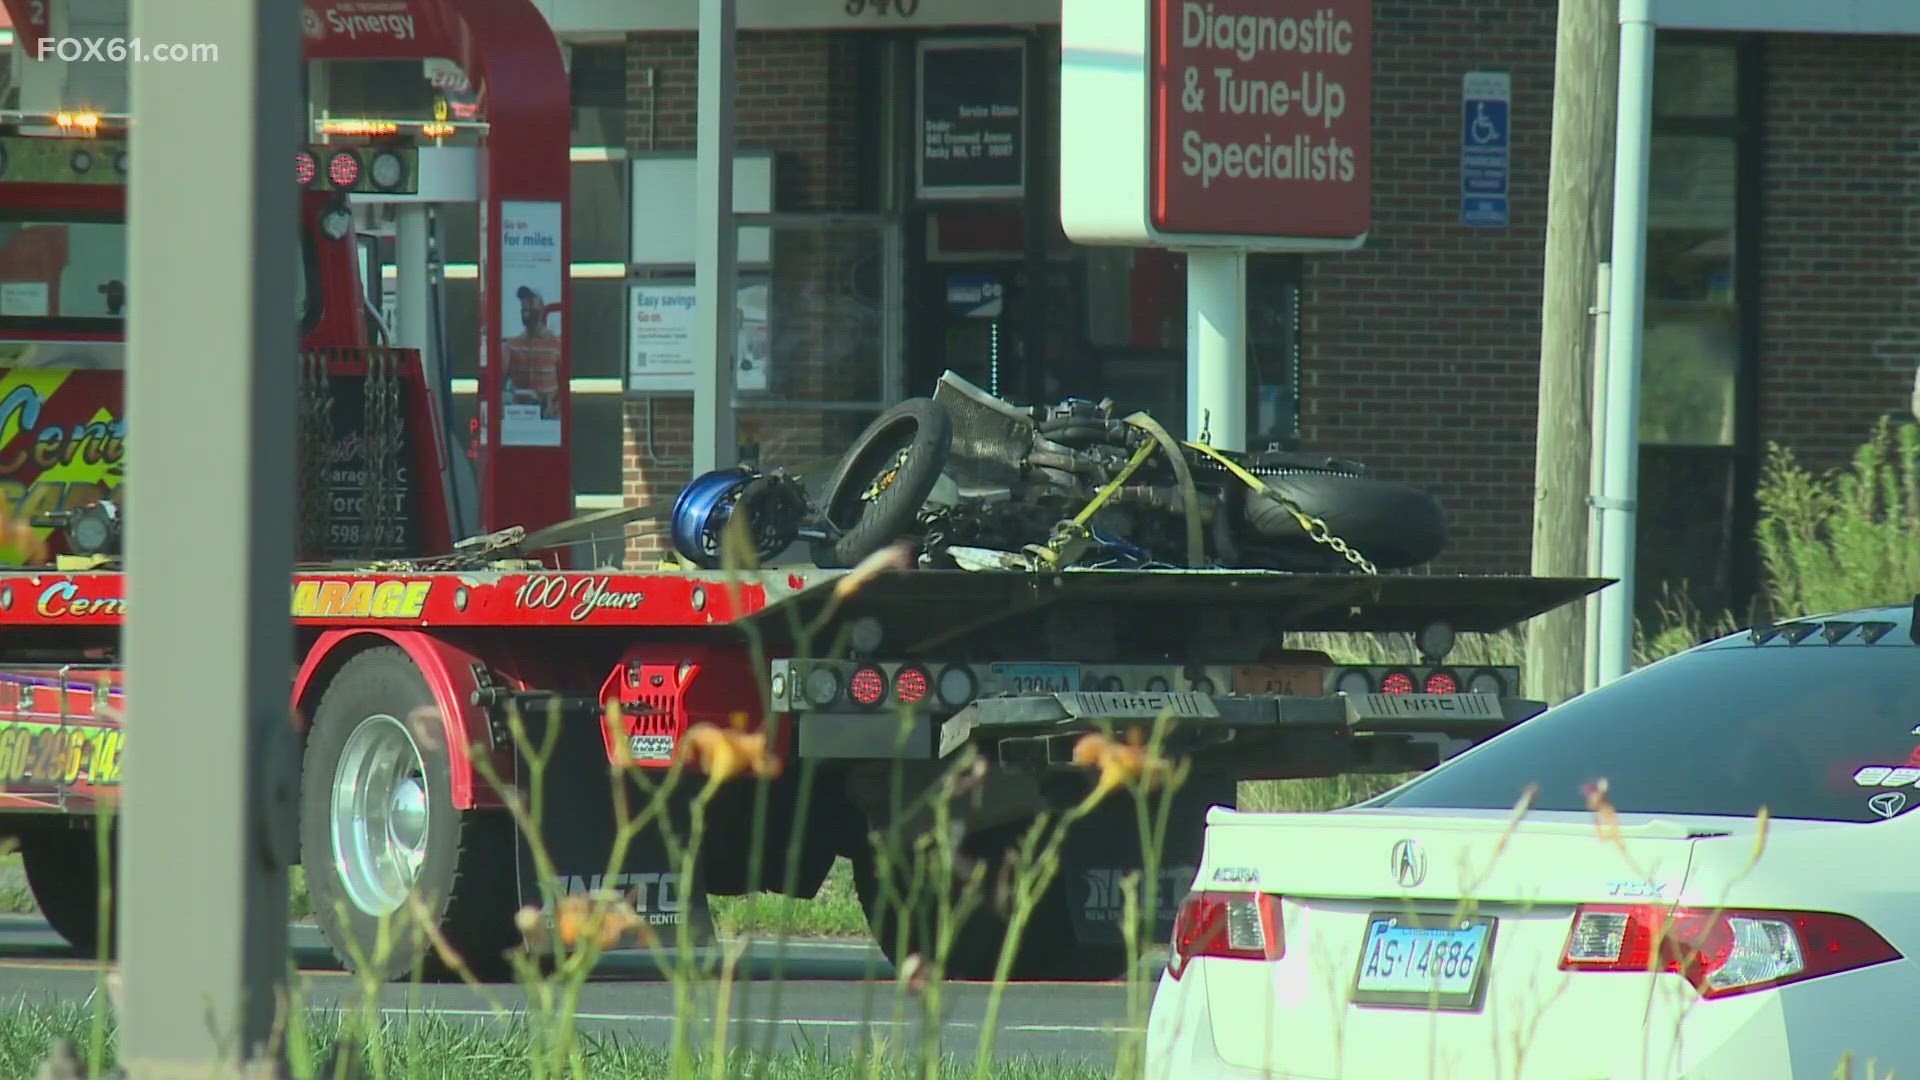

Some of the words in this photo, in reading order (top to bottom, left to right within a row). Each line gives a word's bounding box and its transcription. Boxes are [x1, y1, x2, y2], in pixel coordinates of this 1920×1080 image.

[326, 9, 415, 40] Synergy
[1182, 2, 1353, 62] Diagnostic
[1182, 66, 1204, 113] &
[1214, 68, 1345, 128] Tune-Up
[1182, 130, 1355, 188] Specialists
[503, 231, 520, 247] for
[522, 231, 555, 247] miles.
[638, 293, 660, 309] Easy
[515, 575, 568, 610] 100
[571, 577, 643, 621] Years
[1212, 867, 1260, 882] ACURA
[1606, 882, 1667, 898] TSX
